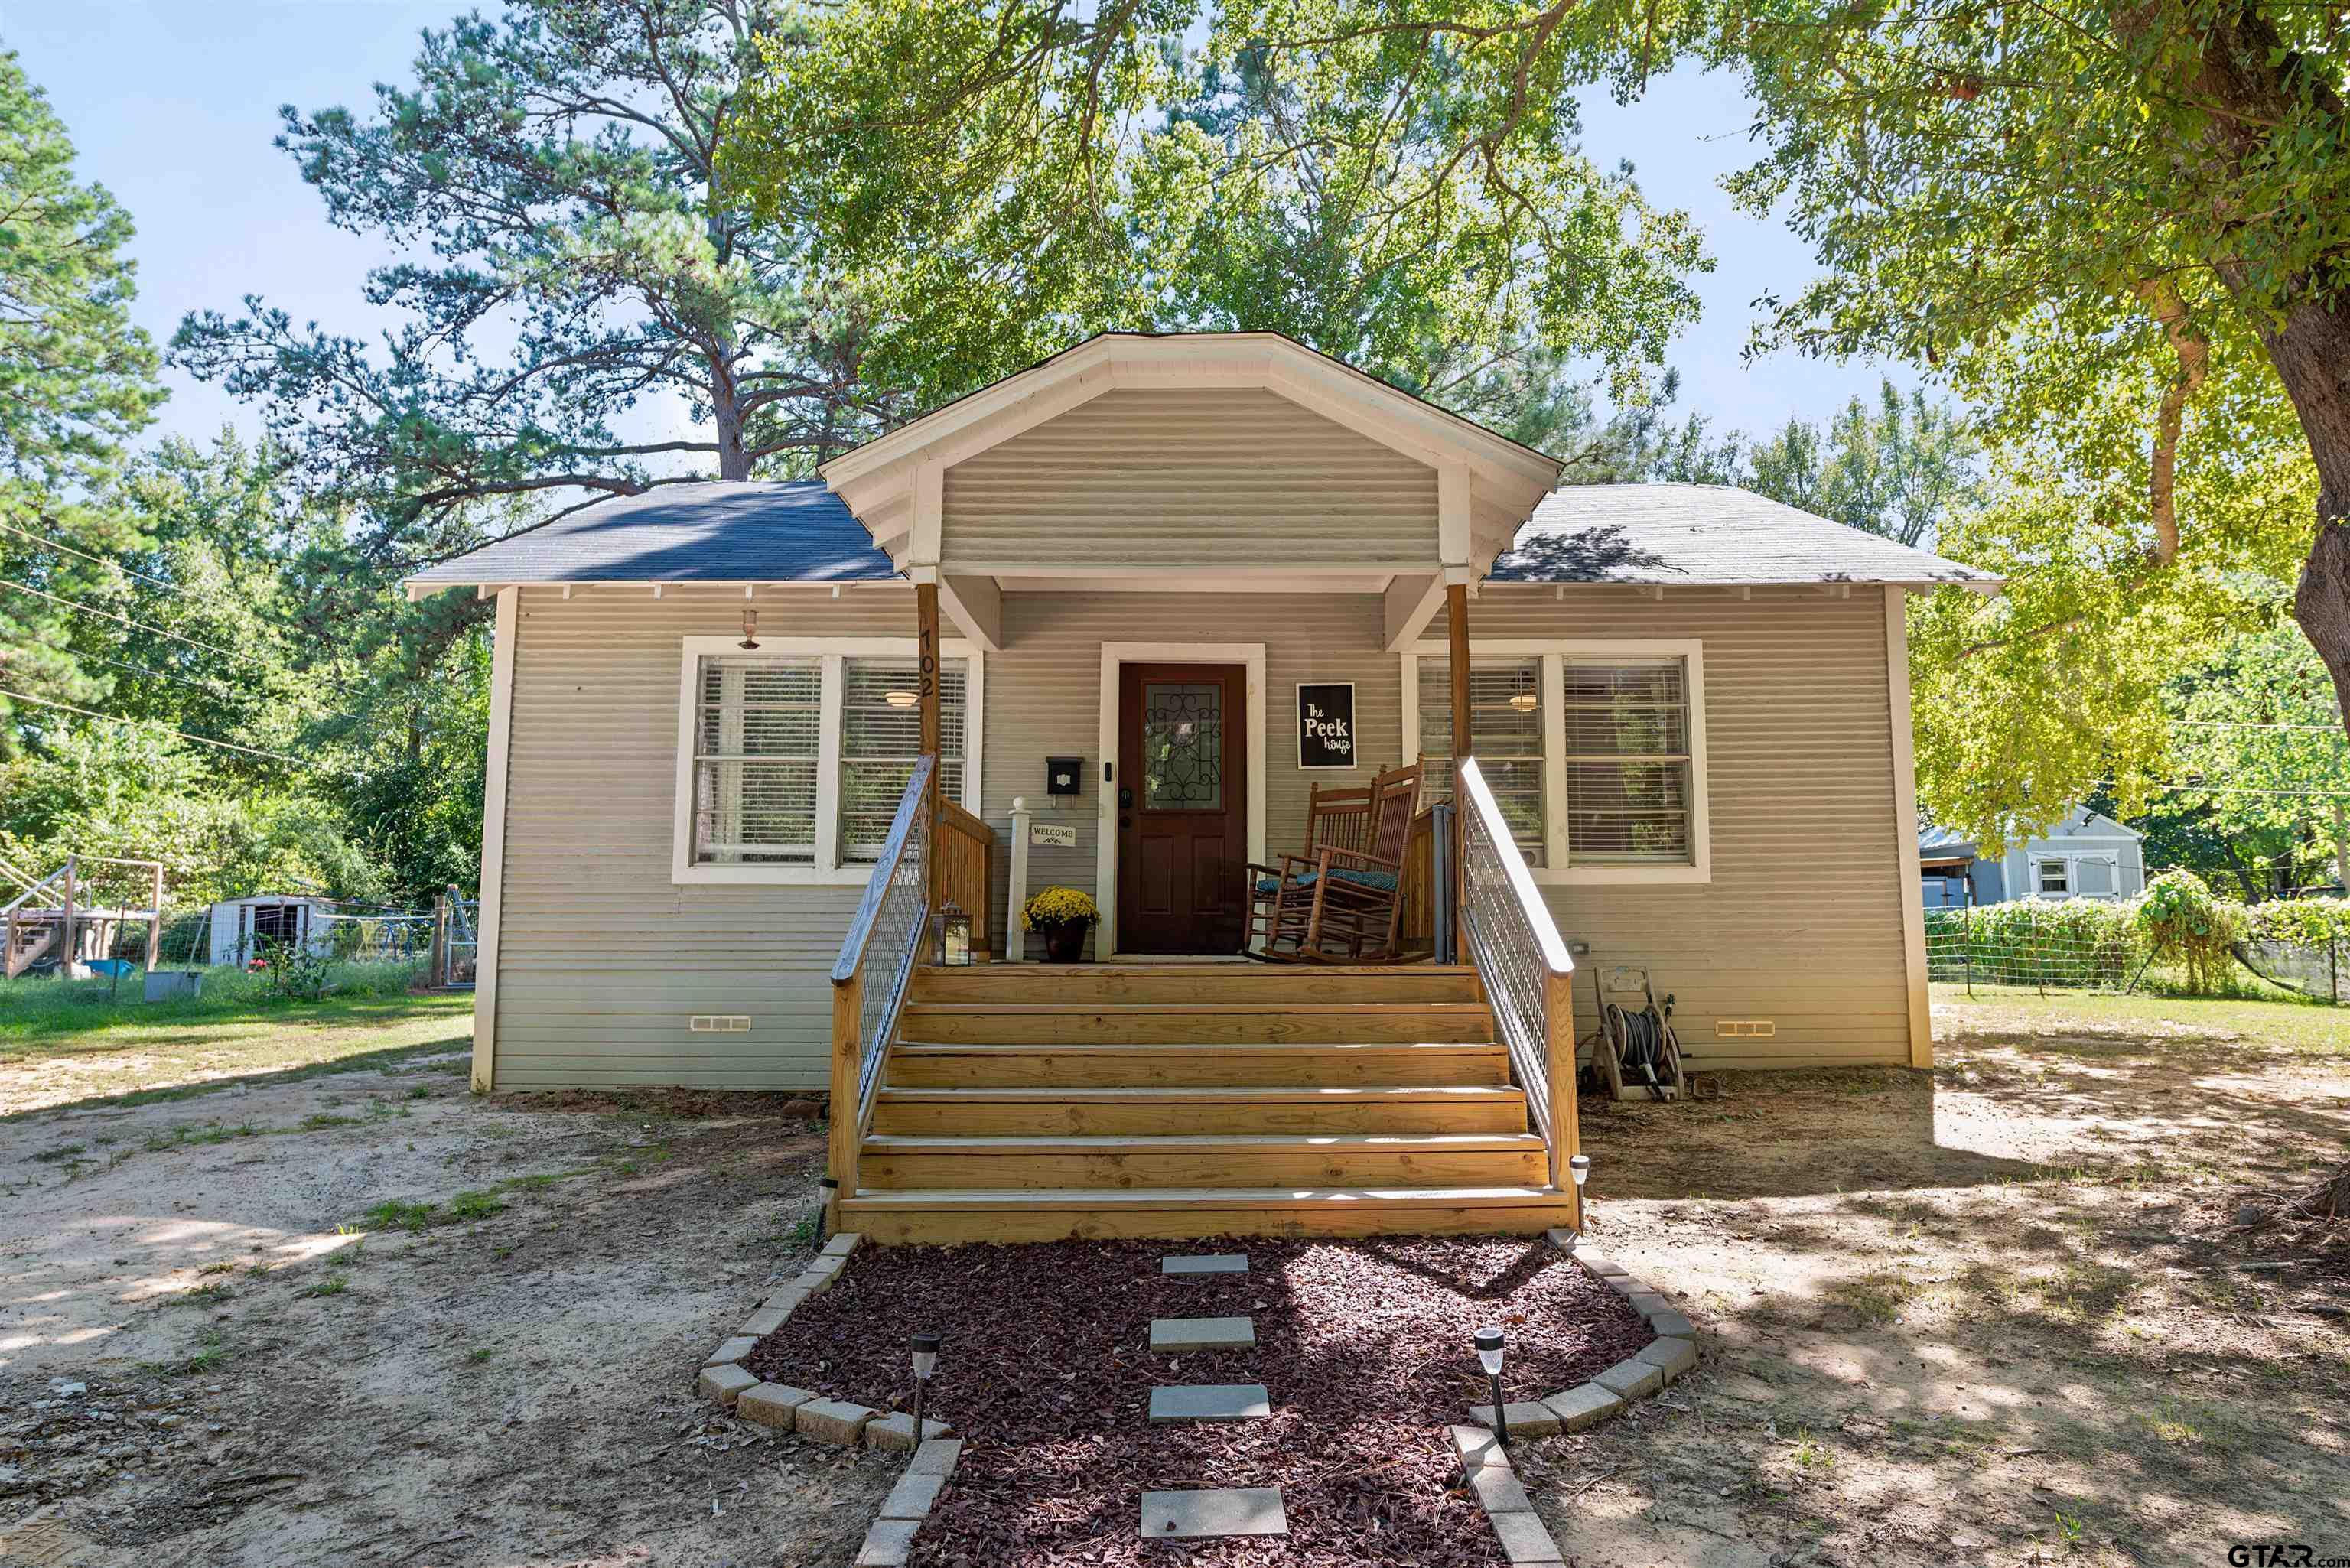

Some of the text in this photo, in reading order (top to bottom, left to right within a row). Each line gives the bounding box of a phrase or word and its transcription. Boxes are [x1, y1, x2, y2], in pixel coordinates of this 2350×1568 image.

[1307, 703, 1325, 717] The
[1304, 718, 1349, 737] Peek
[1324, 736, 1351, 754] house
[1034, 828, 1072, 838] WELCOME
